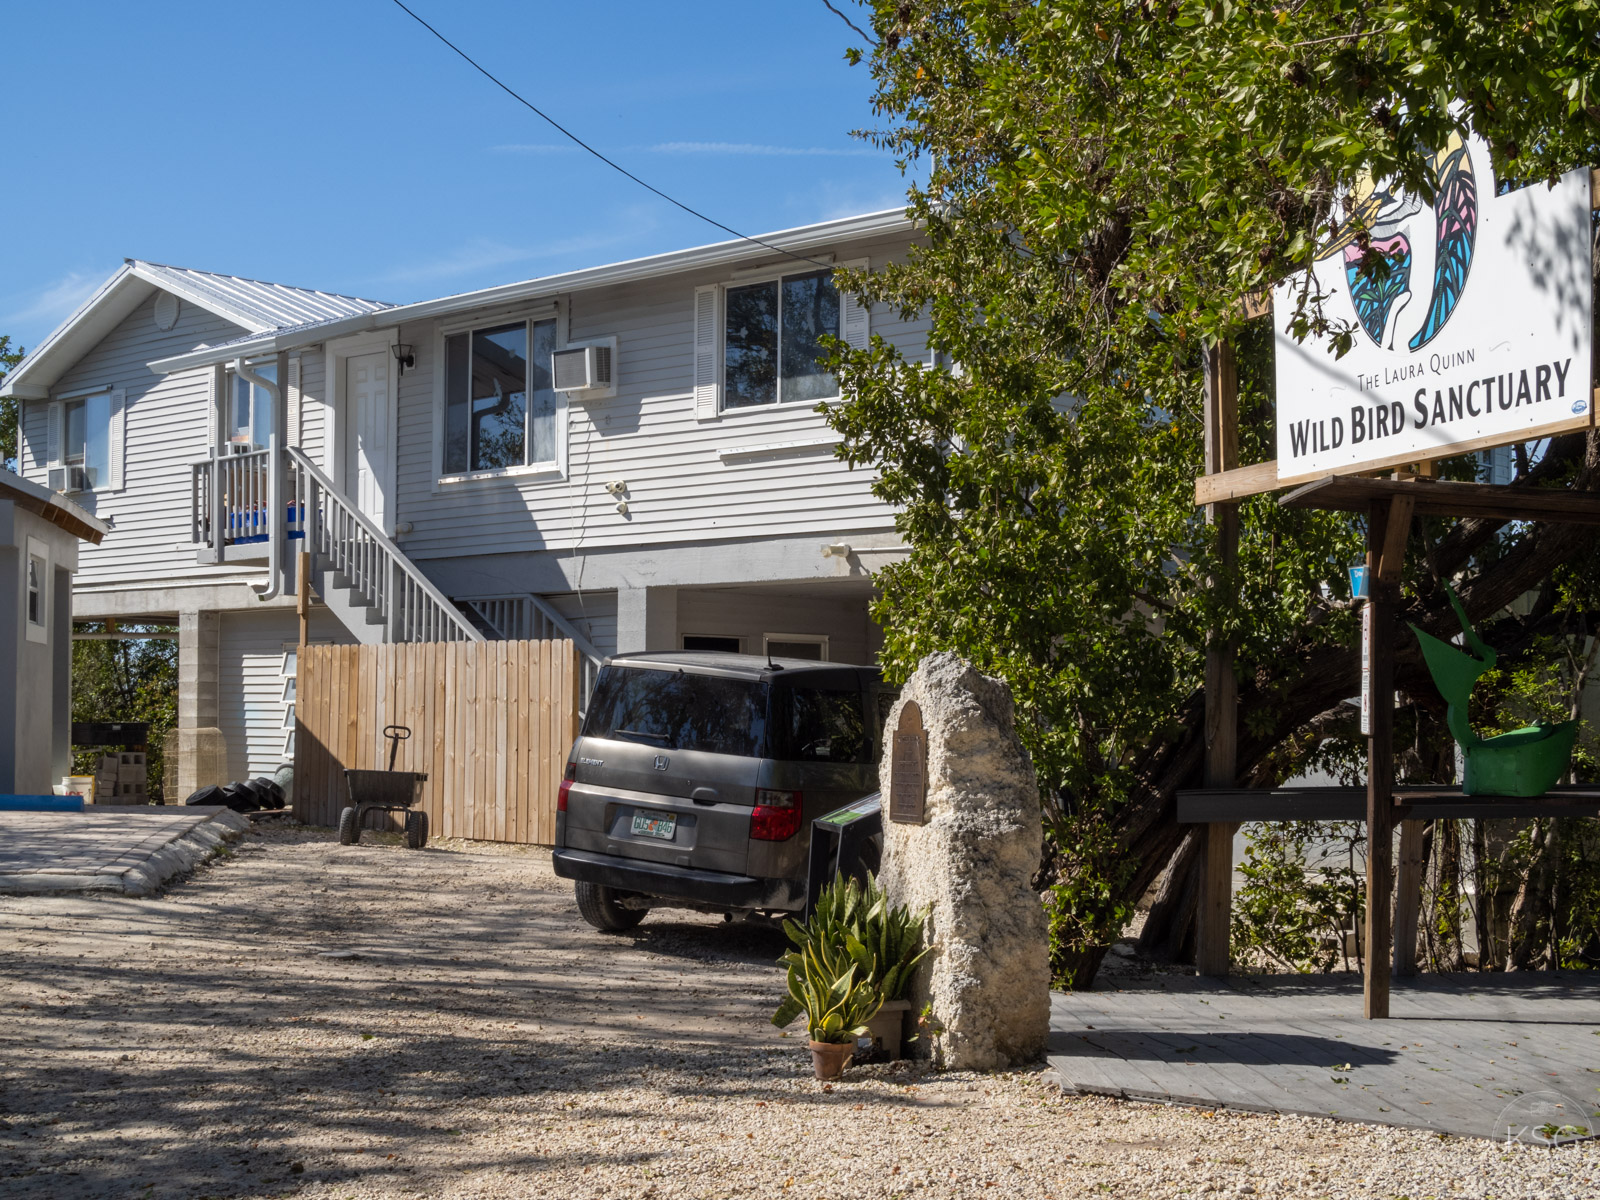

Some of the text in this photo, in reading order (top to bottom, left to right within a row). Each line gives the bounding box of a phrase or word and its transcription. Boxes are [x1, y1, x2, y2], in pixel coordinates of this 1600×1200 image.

[1357, 348, 1475, 392] THE LAURA QUINN
[1289, 358, 1572, 458] WILD BIRD SANCTUARY
